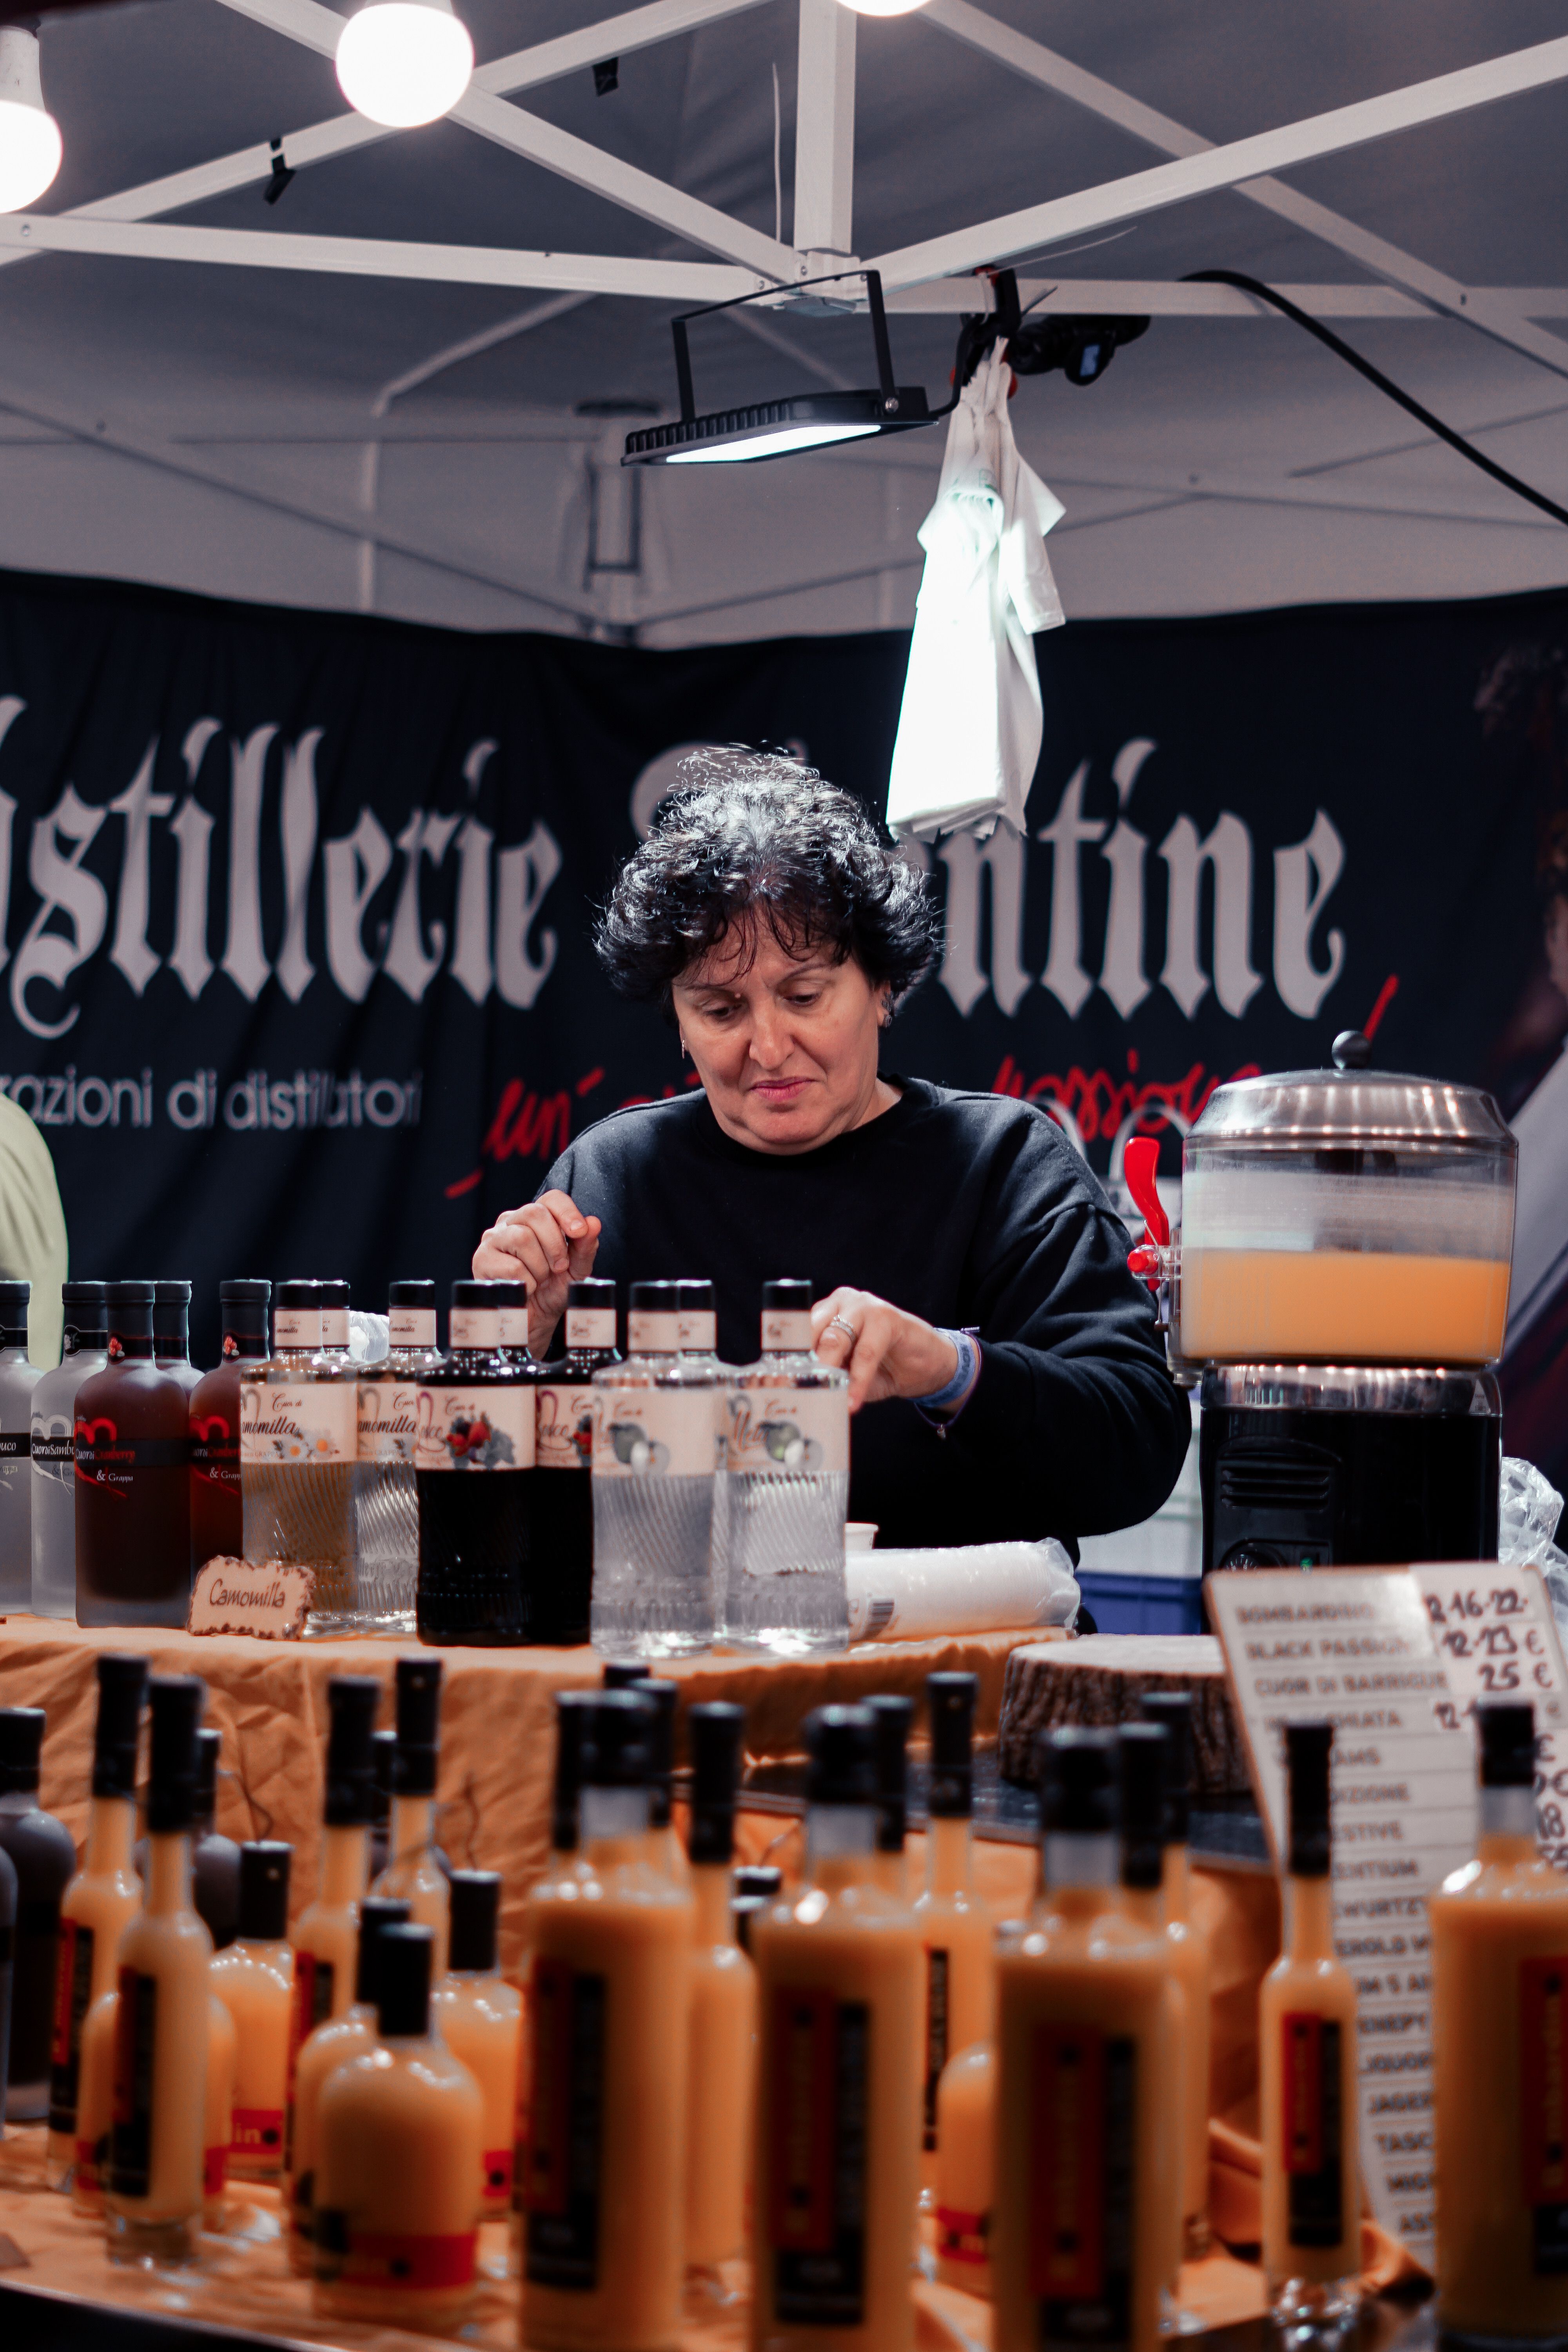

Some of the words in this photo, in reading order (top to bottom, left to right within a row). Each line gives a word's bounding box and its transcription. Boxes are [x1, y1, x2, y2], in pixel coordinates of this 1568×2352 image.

[166, 1068, 218, 1130] di
[96, 1469, 106, 1481] &
[108, 1473, 134, 1484] Grappa
[210, 1466, 219, 1479] &
[209, 1577, 286, 1609] Camomilla
[1245, 1640, 1312, 1661] BLACK
[1256, 1676, 1310, 1697] CUOR
[1477, 1661, 1521, 1691] 25
